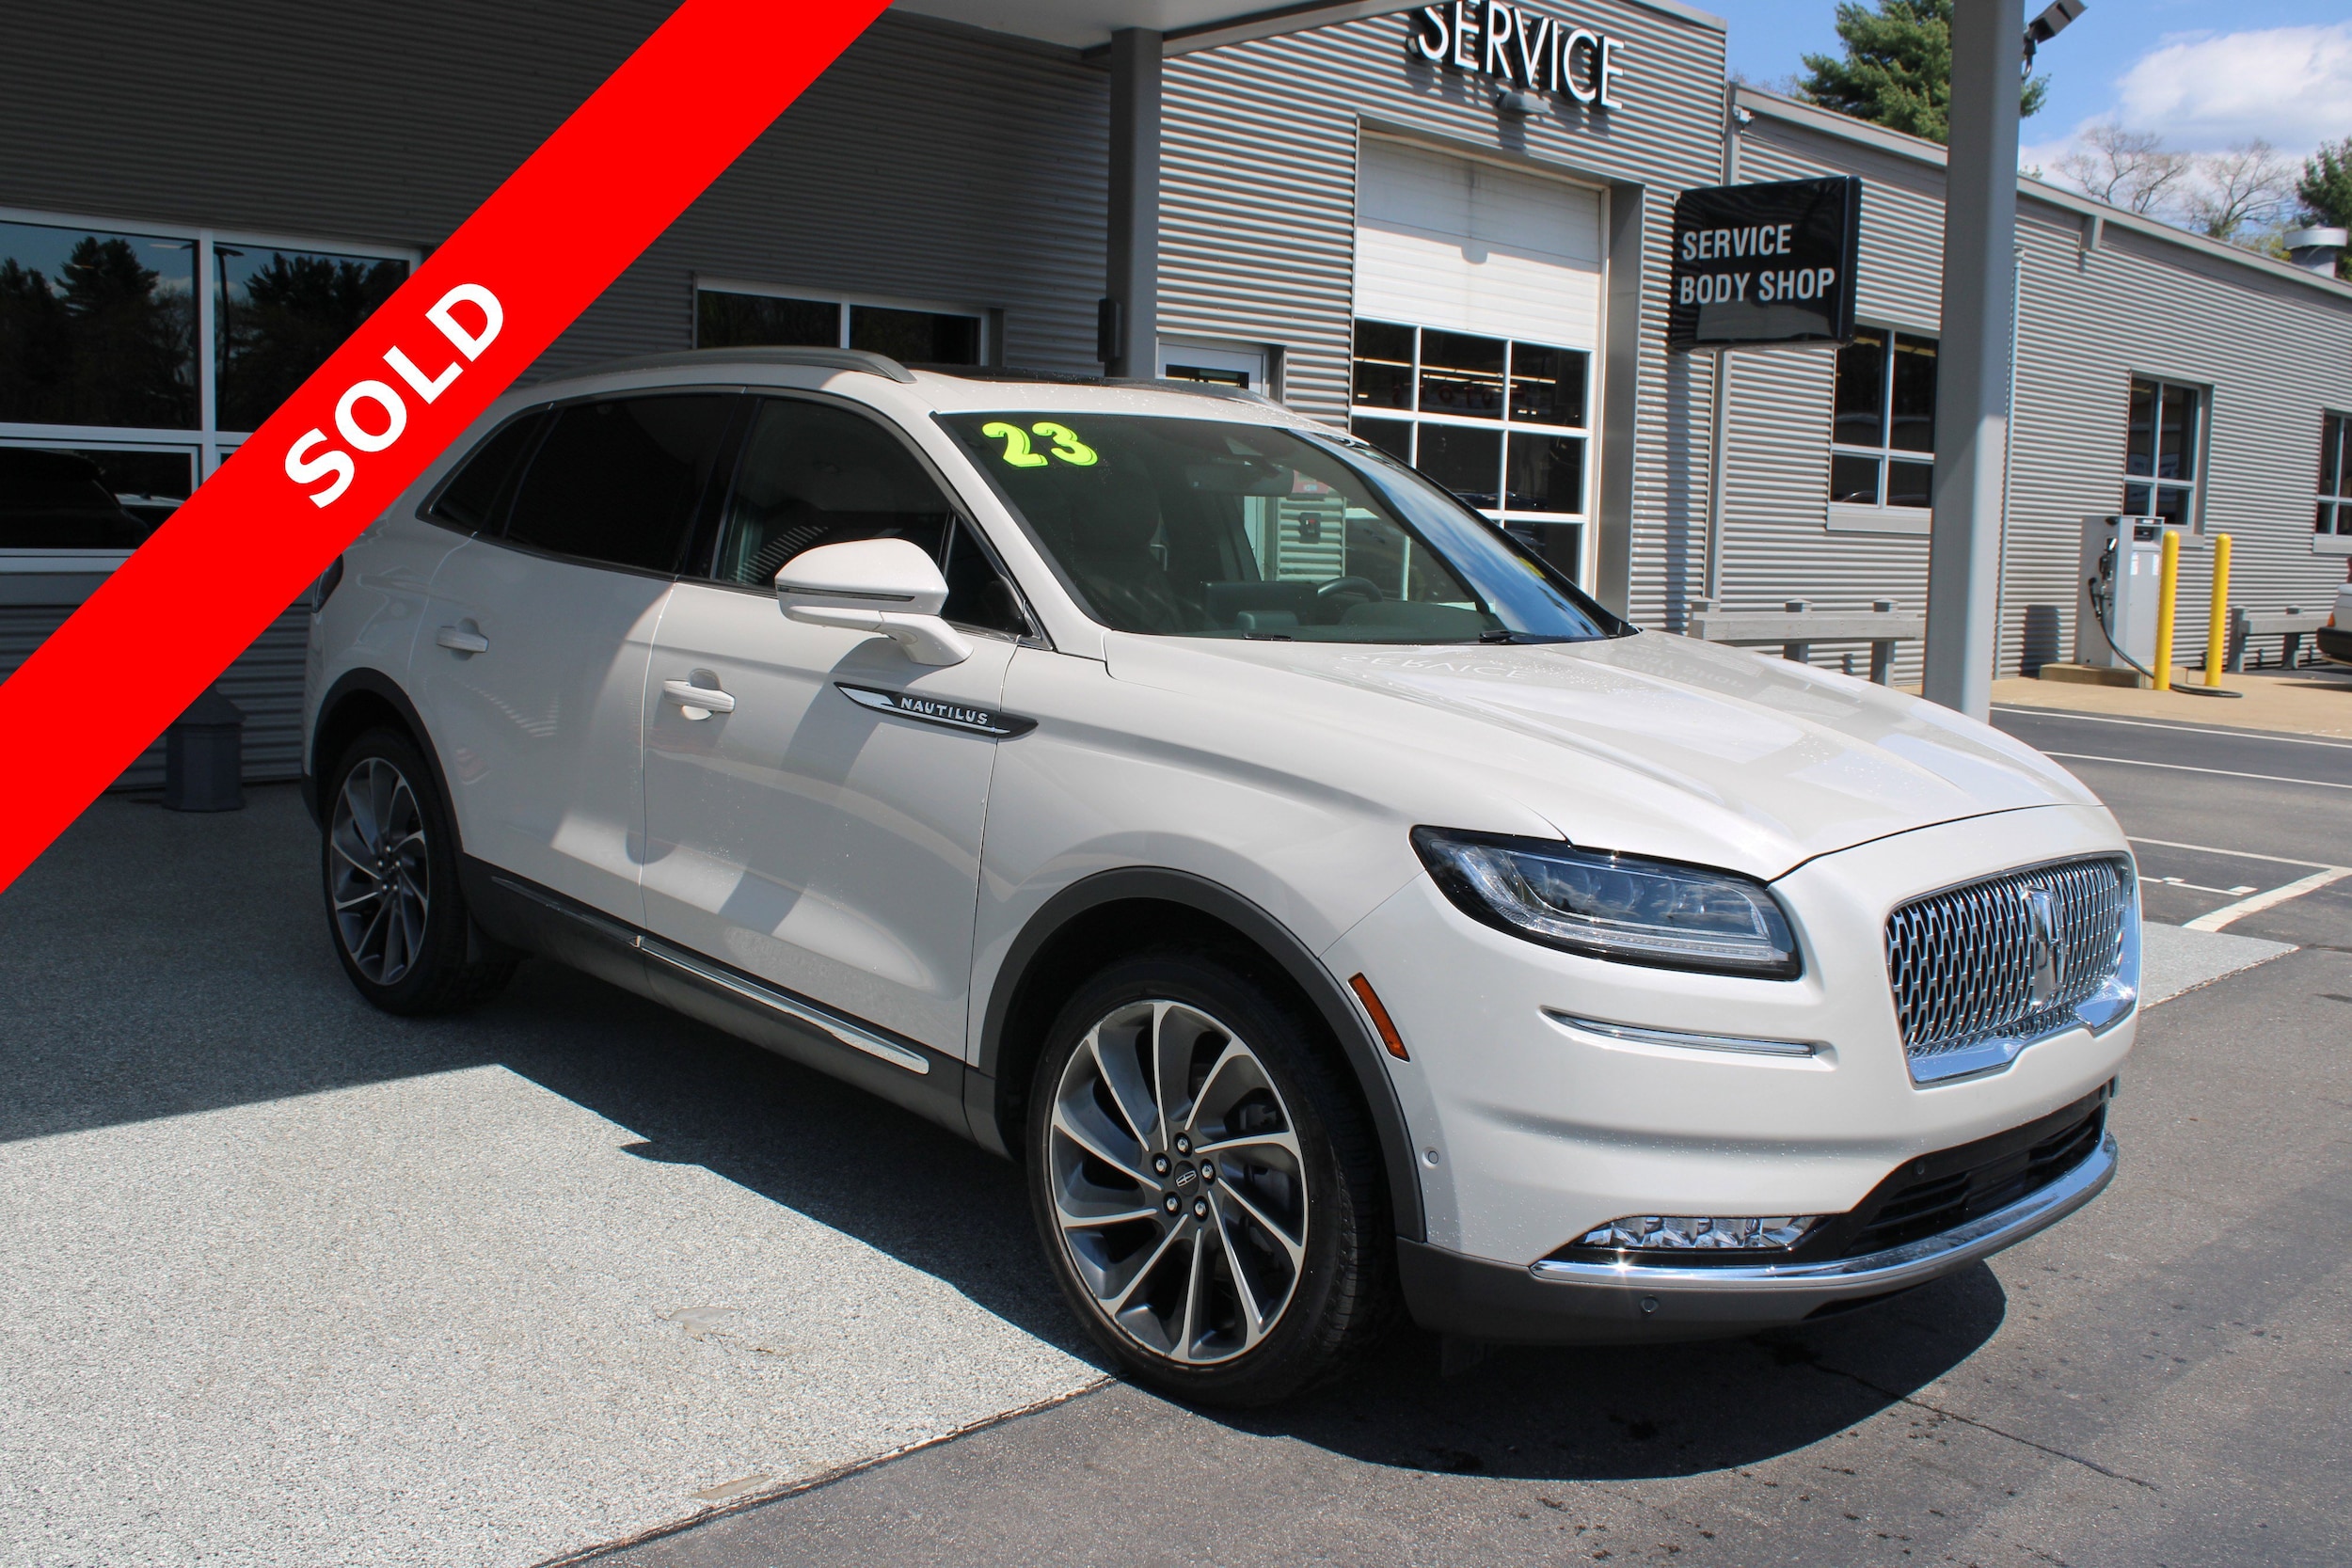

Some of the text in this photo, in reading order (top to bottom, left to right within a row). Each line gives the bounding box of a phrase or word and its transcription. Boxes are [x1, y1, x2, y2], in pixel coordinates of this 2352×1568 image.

[1413, 0, 1626, 110] SERVICE
[1681, 223, 1793, 261] SERVICE
[1679, 267, 1836, 306] BODY SHOP
[981, 420, 1099, 467] 23
[900, 697, 989, 725] NAUTILUS
